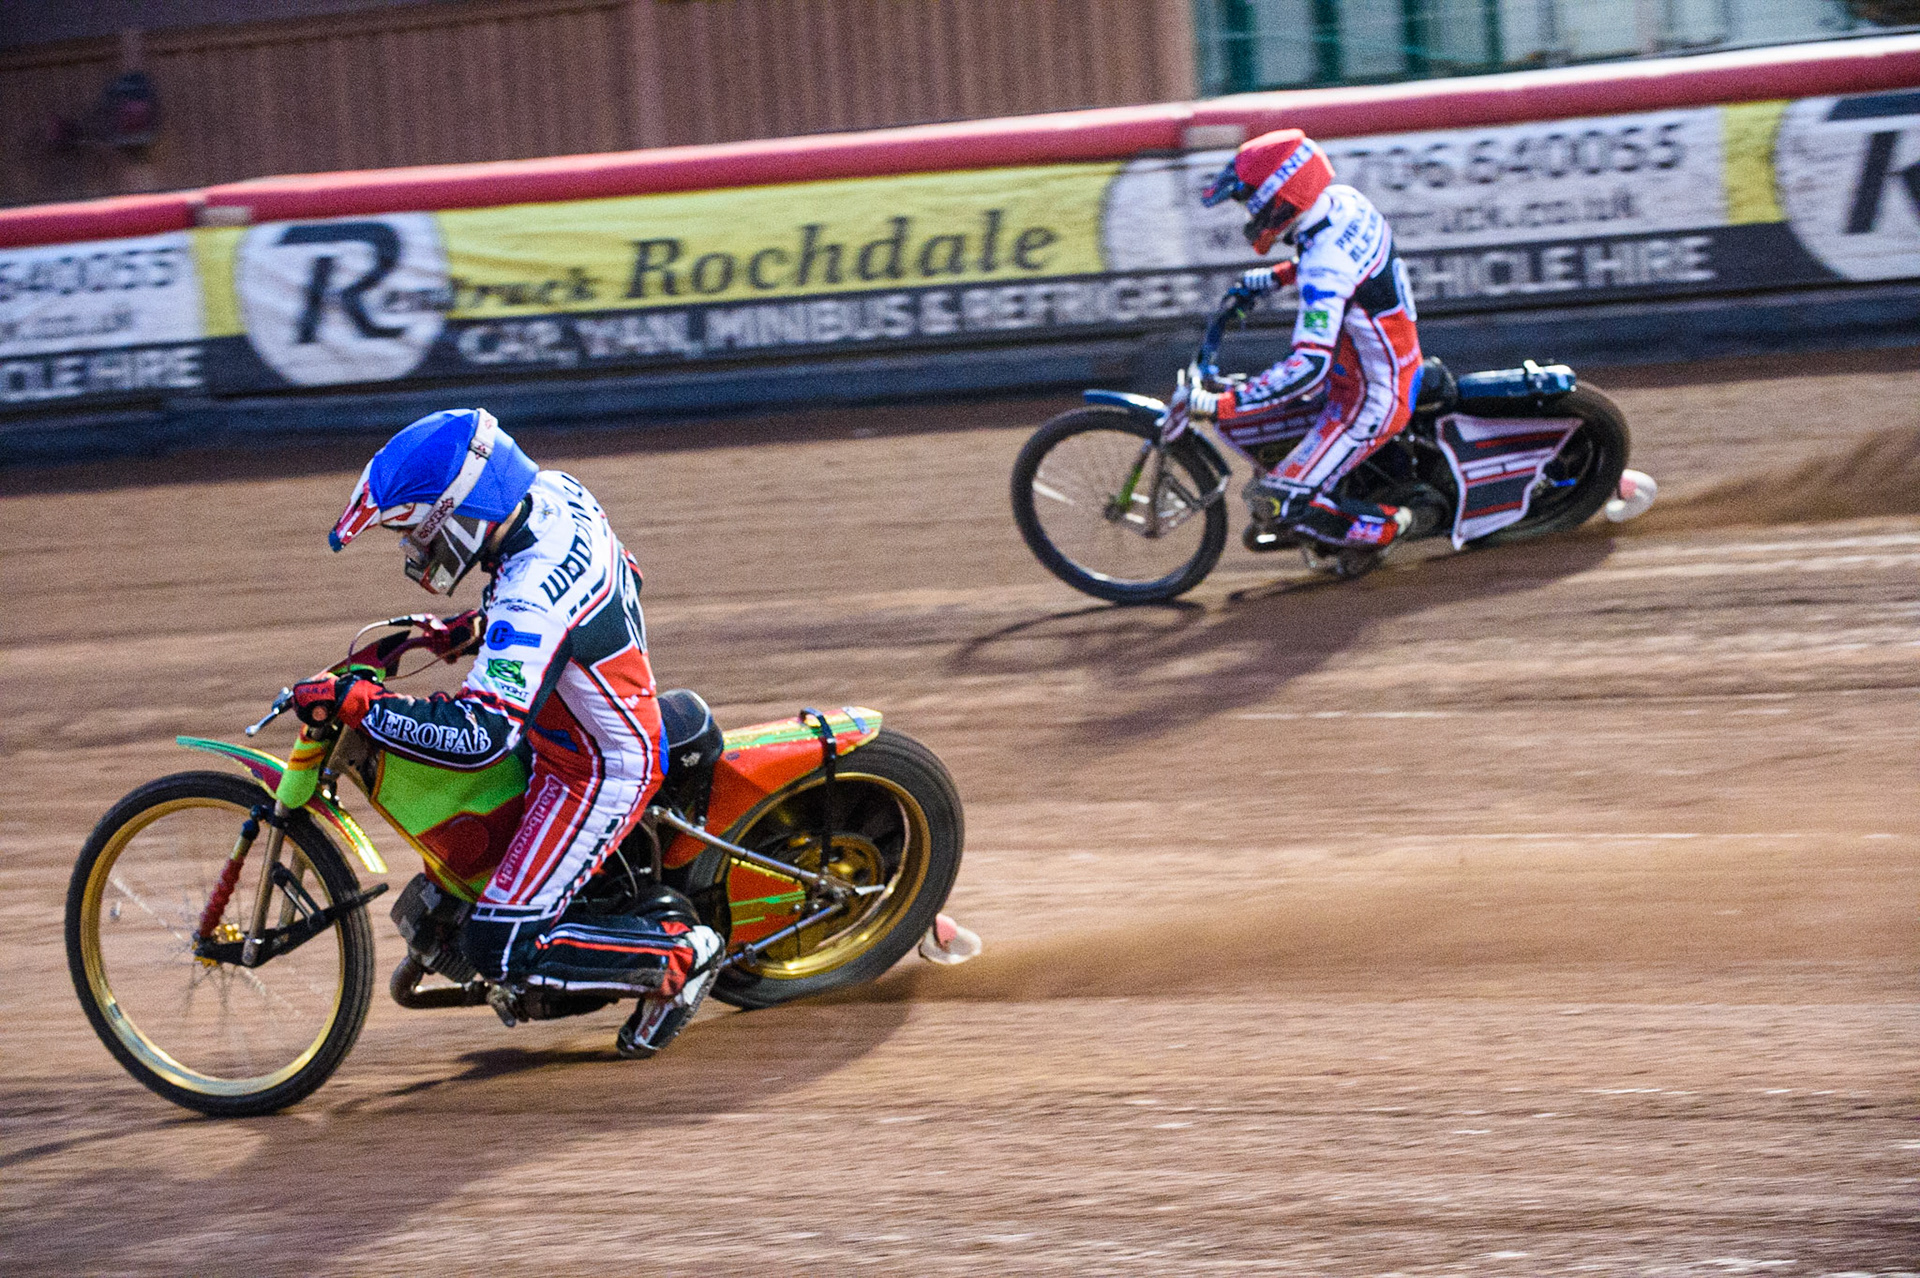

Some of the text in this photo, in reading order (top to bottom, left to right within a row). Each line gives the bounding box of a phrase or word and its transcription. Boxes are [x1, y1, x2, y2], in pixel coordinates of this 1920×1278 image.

[622, 206, 1062, 300] Rochdale
[1585, 234, 1714, 293] HIRE
[360, 703, 492, 754] AEROFAB
[495, 780, 560, 886] Marlborough
